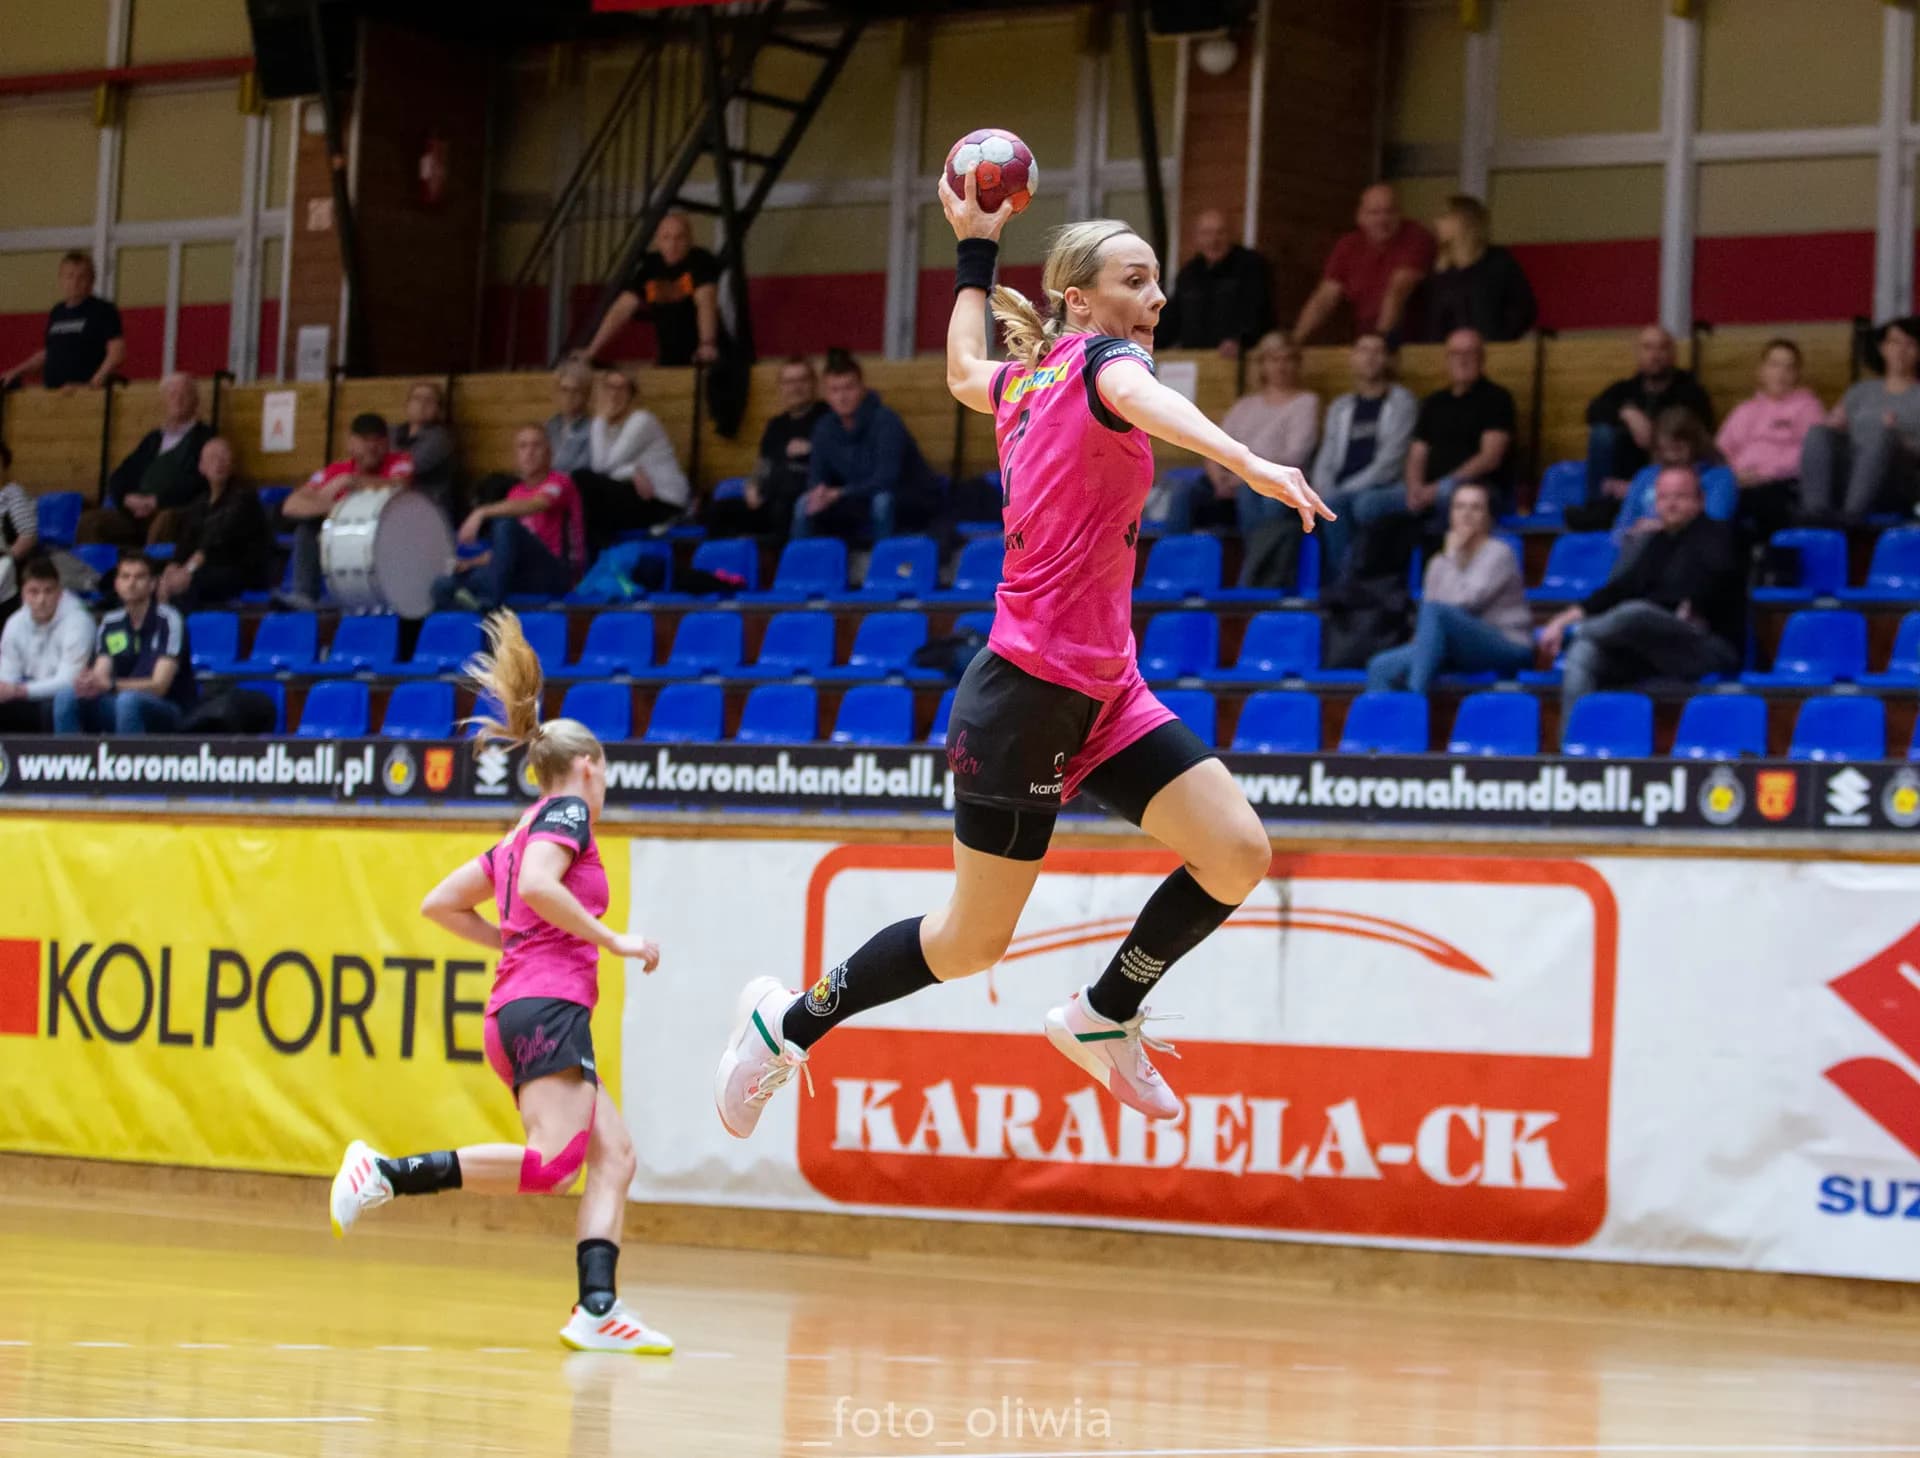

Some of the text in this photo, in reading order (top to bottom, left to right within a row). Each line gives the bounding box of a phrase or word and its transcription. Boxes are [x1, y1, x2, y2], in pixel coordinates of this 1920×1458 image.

[18, 742, 374, 796] www.koronahandball.pl
[47, 940, 485, 1064] KOLPORTE
[831, 1079, 1567, 1190] KARABELA-CK
